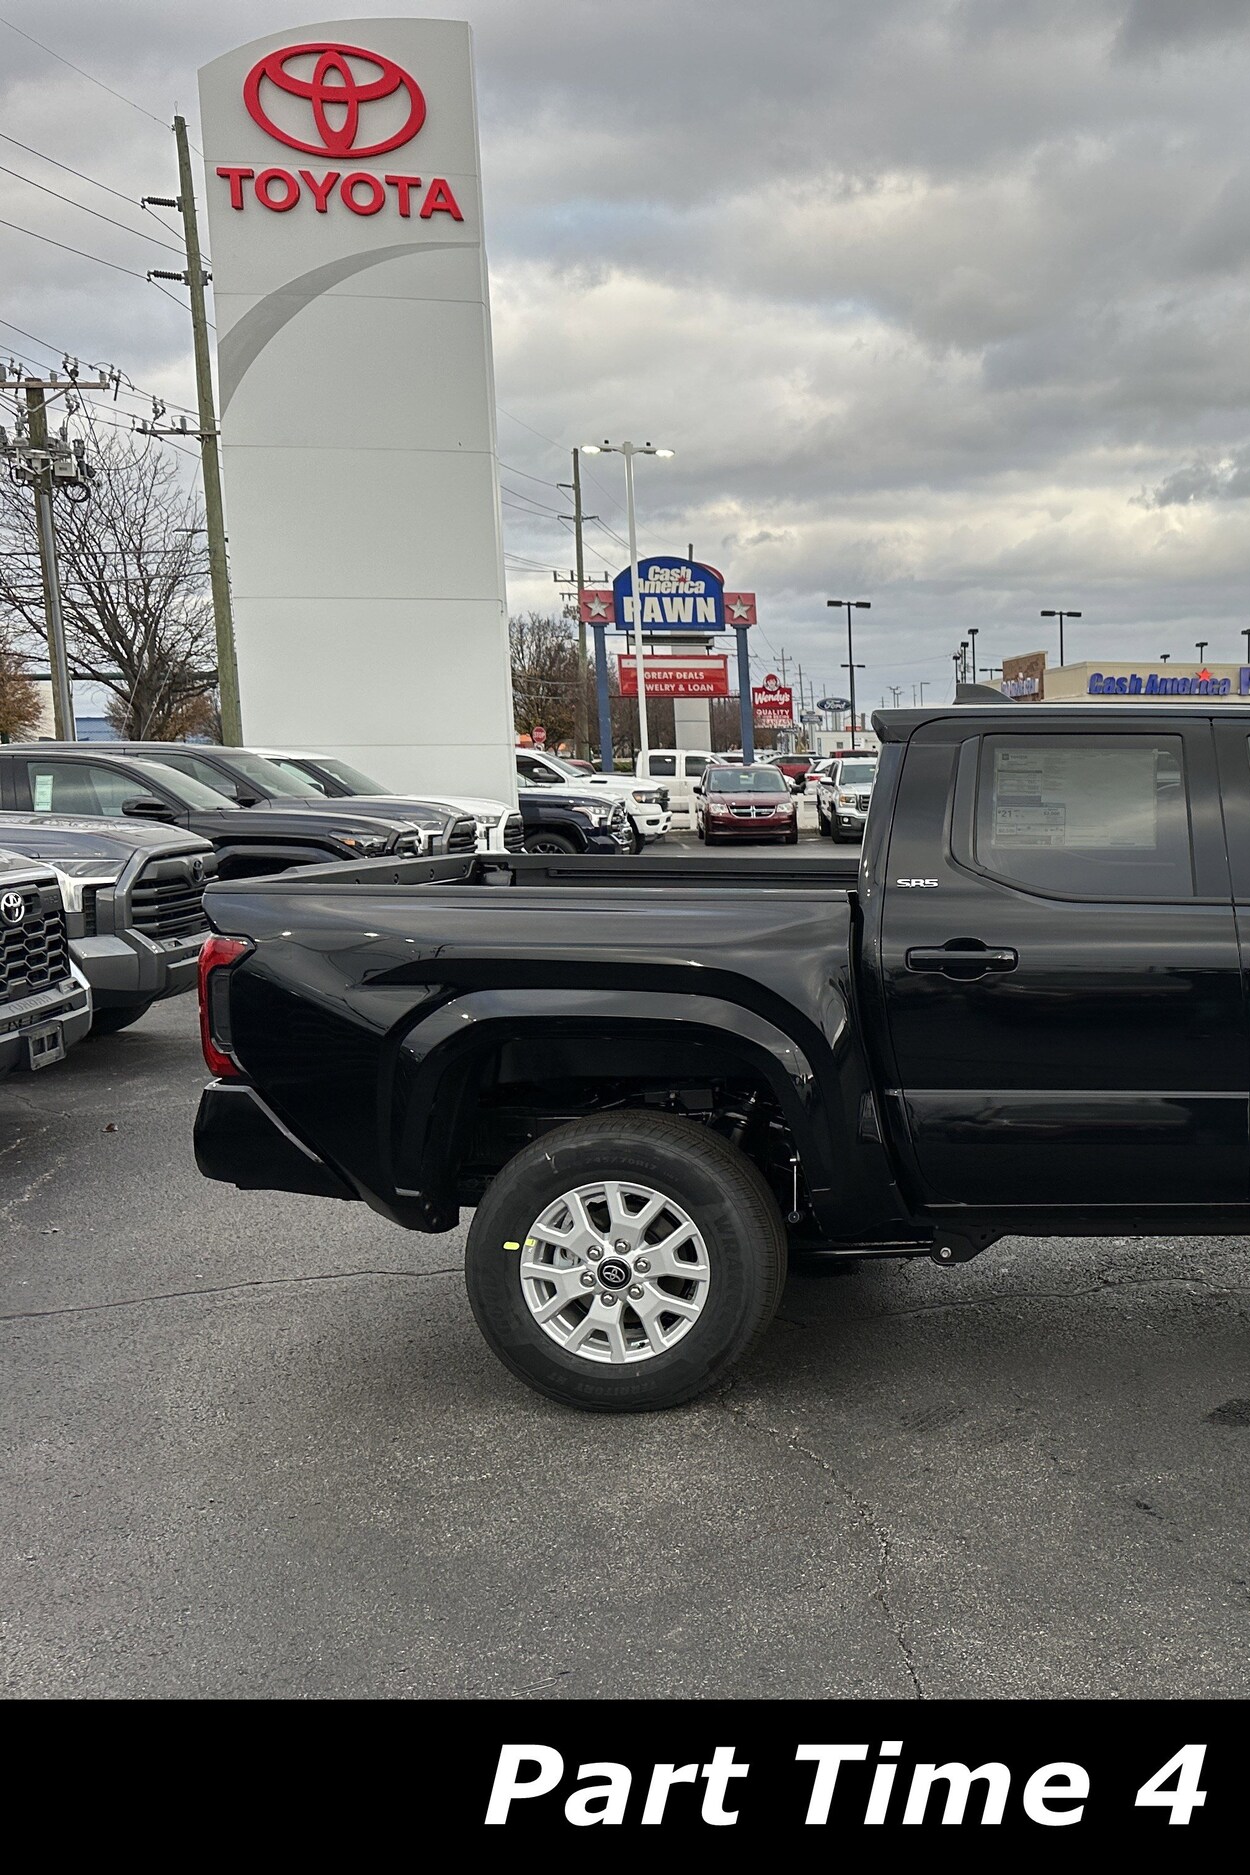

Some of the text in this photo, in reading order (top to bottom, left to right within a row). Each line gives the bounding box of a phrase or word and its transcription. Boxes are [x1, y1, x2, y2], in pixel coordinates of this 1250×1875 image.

[216, 167, 464, 221] TOYOTA
[648, 566, 692, 581] Cash
[644, 671, 704, 679] GREAT DEALS
[1088, 673, 1142, 695] Cash
[1144, 674, 1231, 696] America
[754, 690, 790, 705] Wendy's
[824, 701, 846, 709] Ford
[896, 878, 939, 888] SR5
